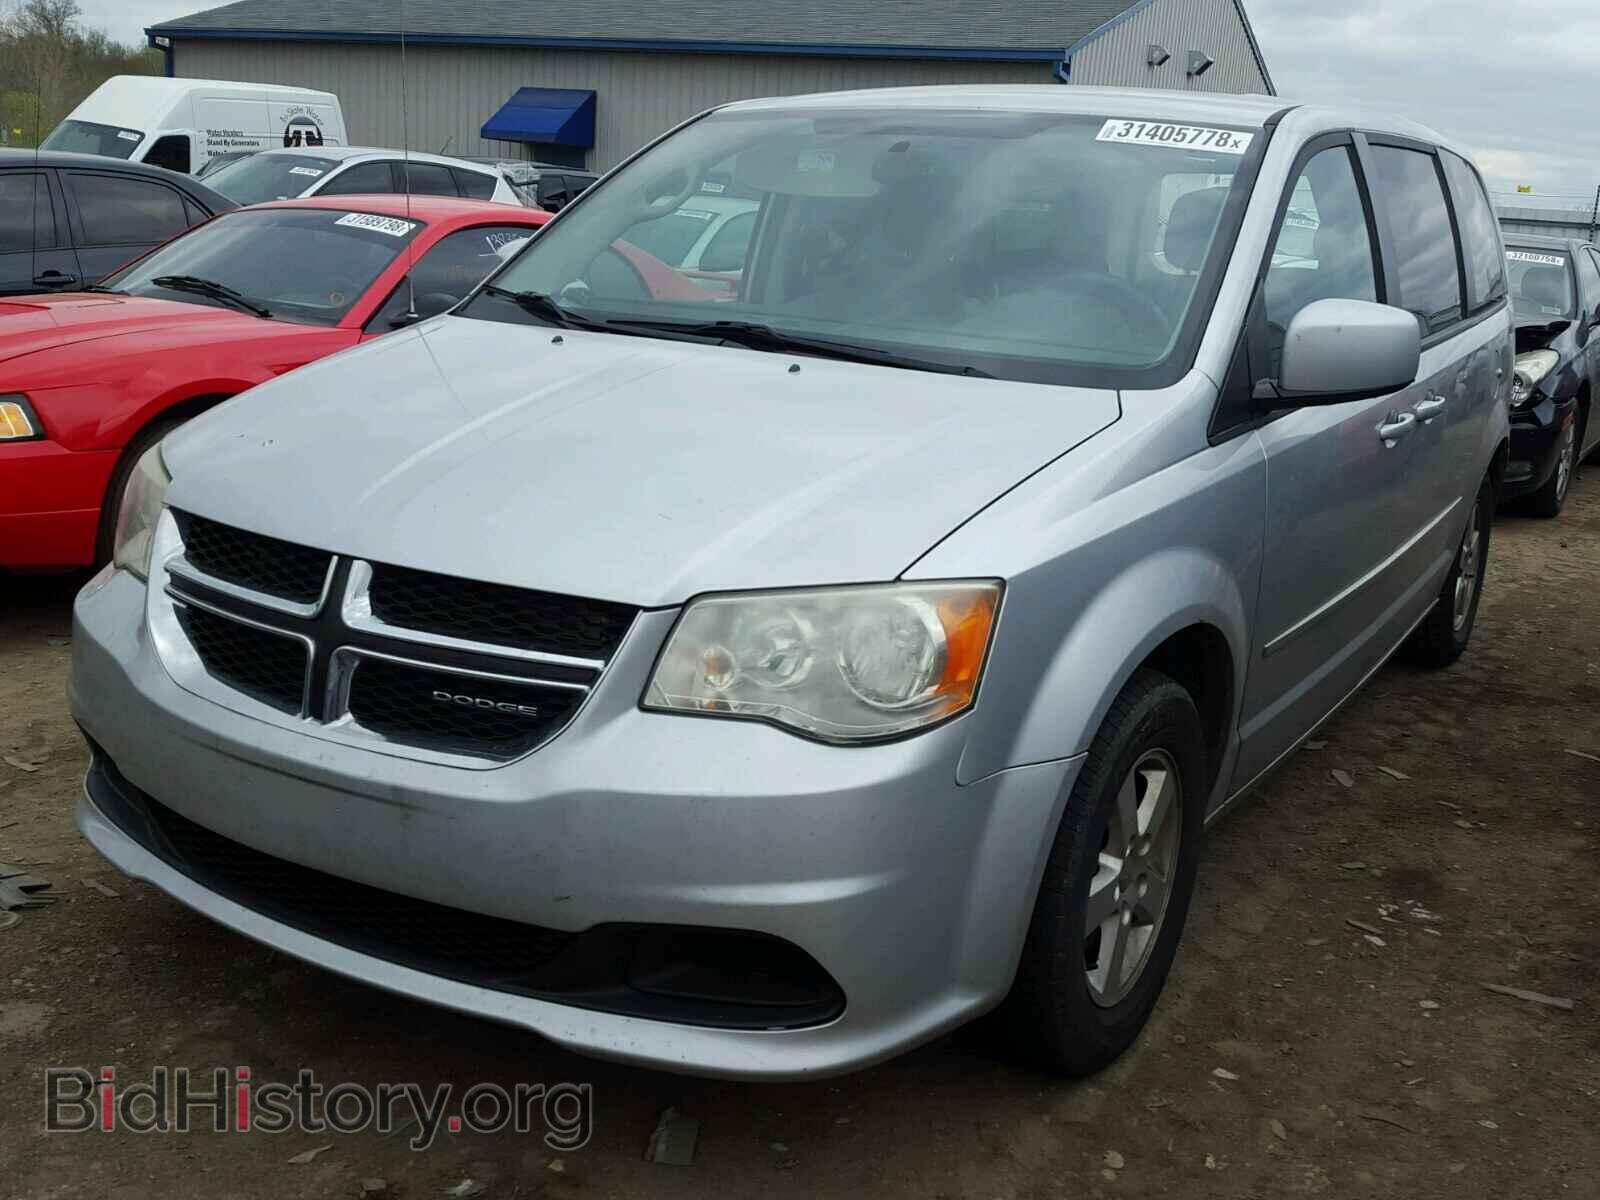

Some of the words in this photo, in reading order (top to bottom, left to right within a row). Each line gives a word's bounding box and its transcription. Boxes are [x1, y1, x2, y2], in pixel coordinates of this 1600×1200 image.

[206, 138, 223, 146] Stand
[231, 138, 260, 146] Generators
[433, 690, 537, 716] DODGE
